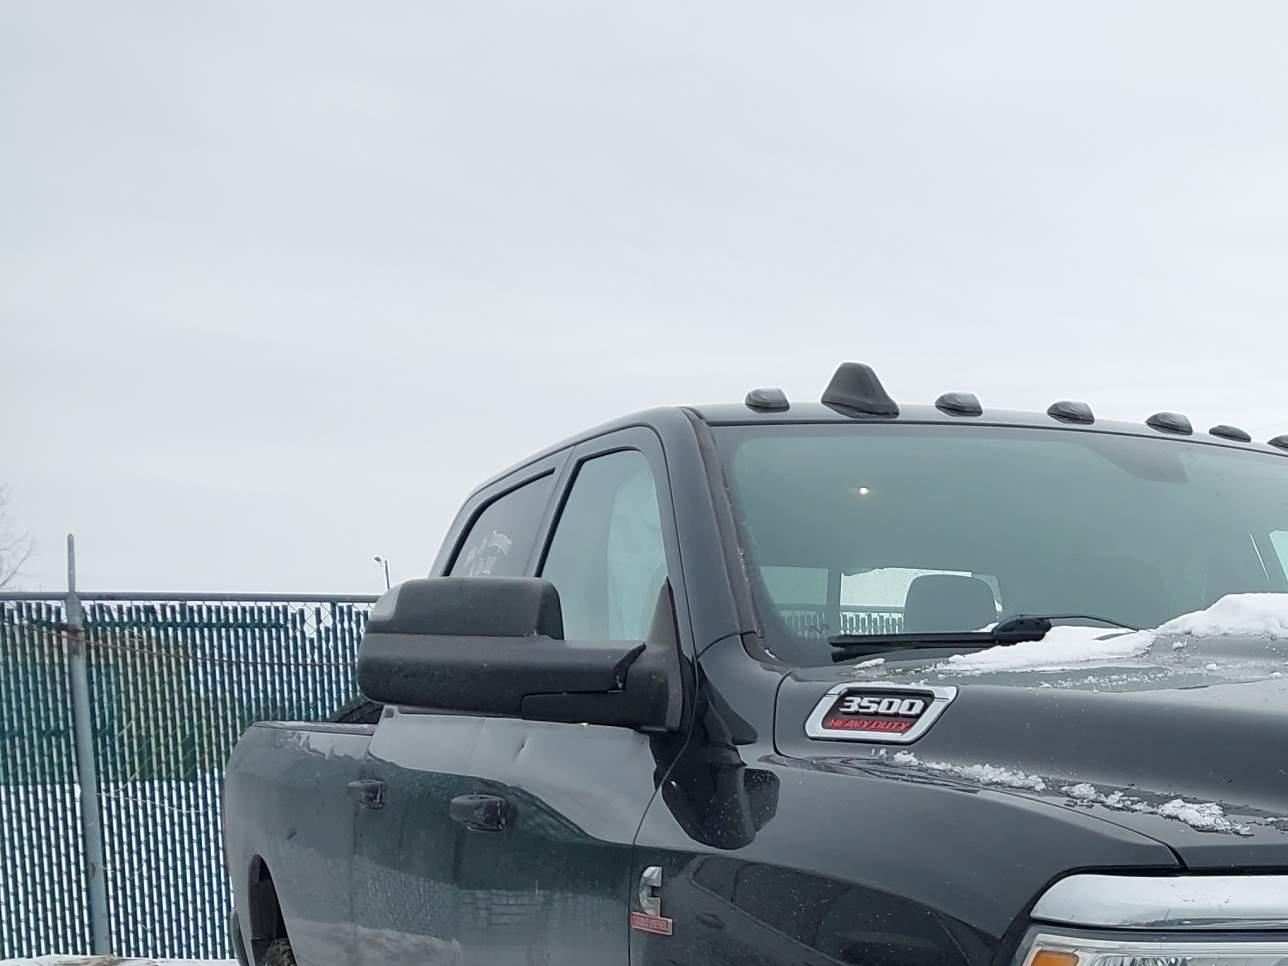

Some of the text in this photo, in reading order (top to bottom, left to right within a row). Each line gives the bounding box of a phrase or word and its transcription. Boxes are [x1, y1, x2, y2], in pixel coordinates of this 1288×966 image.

[838, 696, 925, 715] 3500
[829, 719, 911, 732] HEAVY DUTY
